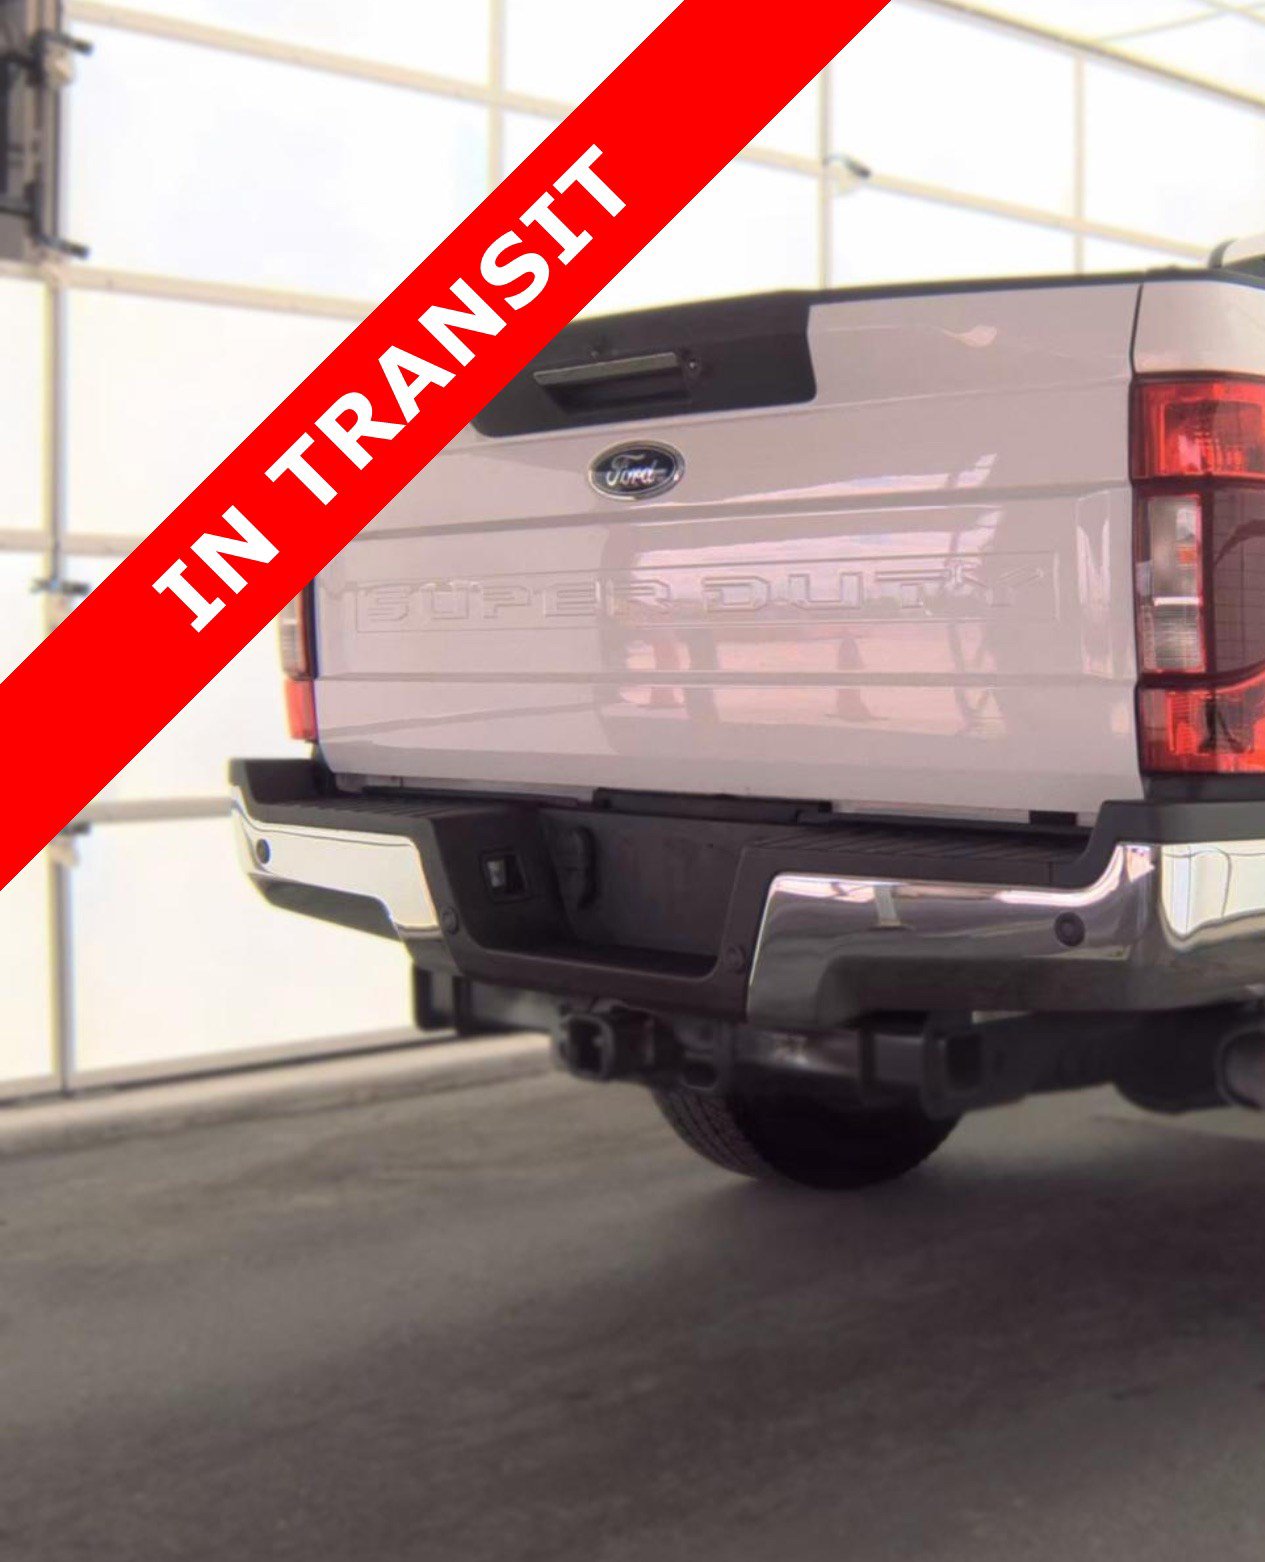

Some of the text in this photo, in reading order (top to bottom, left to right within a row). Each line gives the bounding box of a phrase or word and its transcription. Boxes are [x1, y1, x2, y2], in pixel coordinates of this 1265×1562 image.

[605, 453, 667, 486] Ford
[364, 565, 1046, 622] SUPER DUTY
